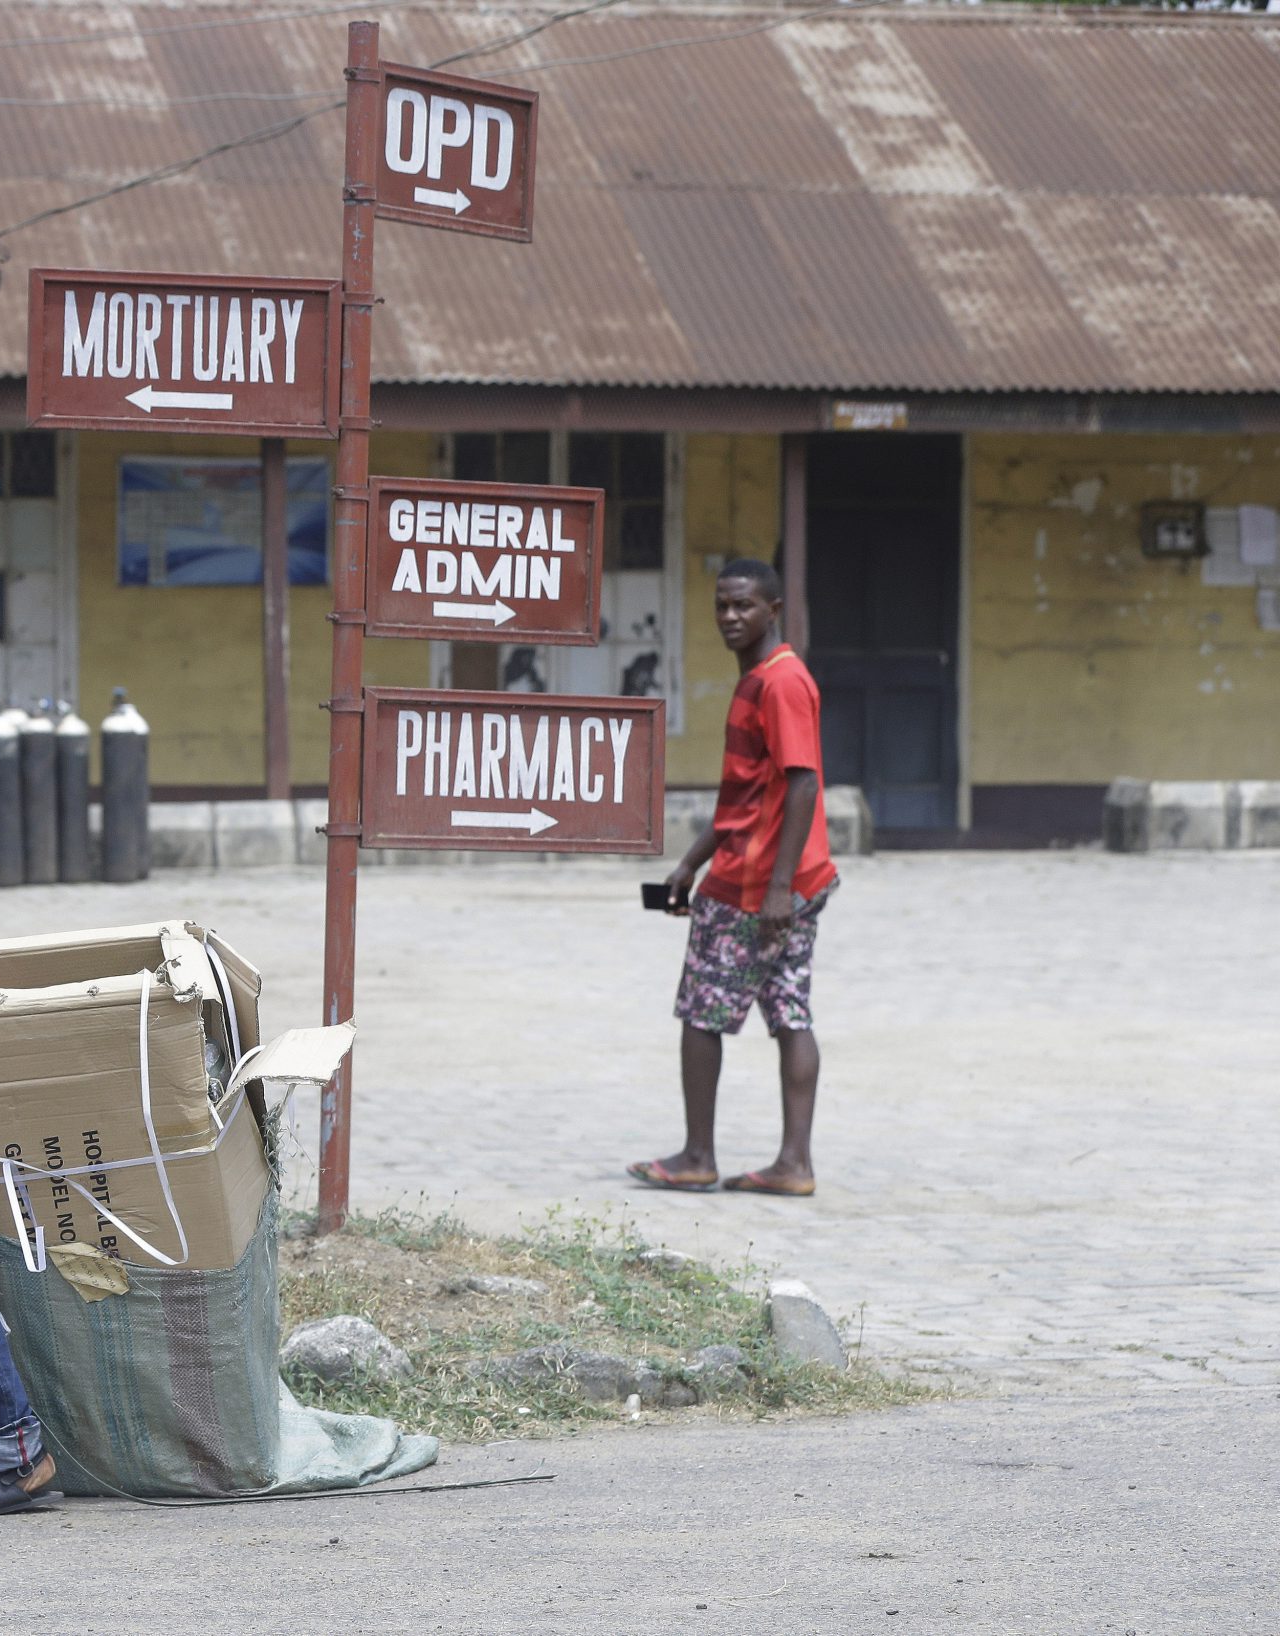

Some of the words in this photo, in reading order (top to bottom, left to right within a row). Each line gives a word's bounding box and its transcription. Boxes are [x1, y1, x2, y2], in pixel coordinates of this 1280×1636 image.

[385, 86, 513, 192] OPD
[62, 290, 304, 385] MORTUARY
[388, 498, 576, 553] GENERAL
[391, 548, 562, 601] ADMIN
[396, 710, 633, 804] PHARMACY
[42, 1136, 70, 1210] MODEL
